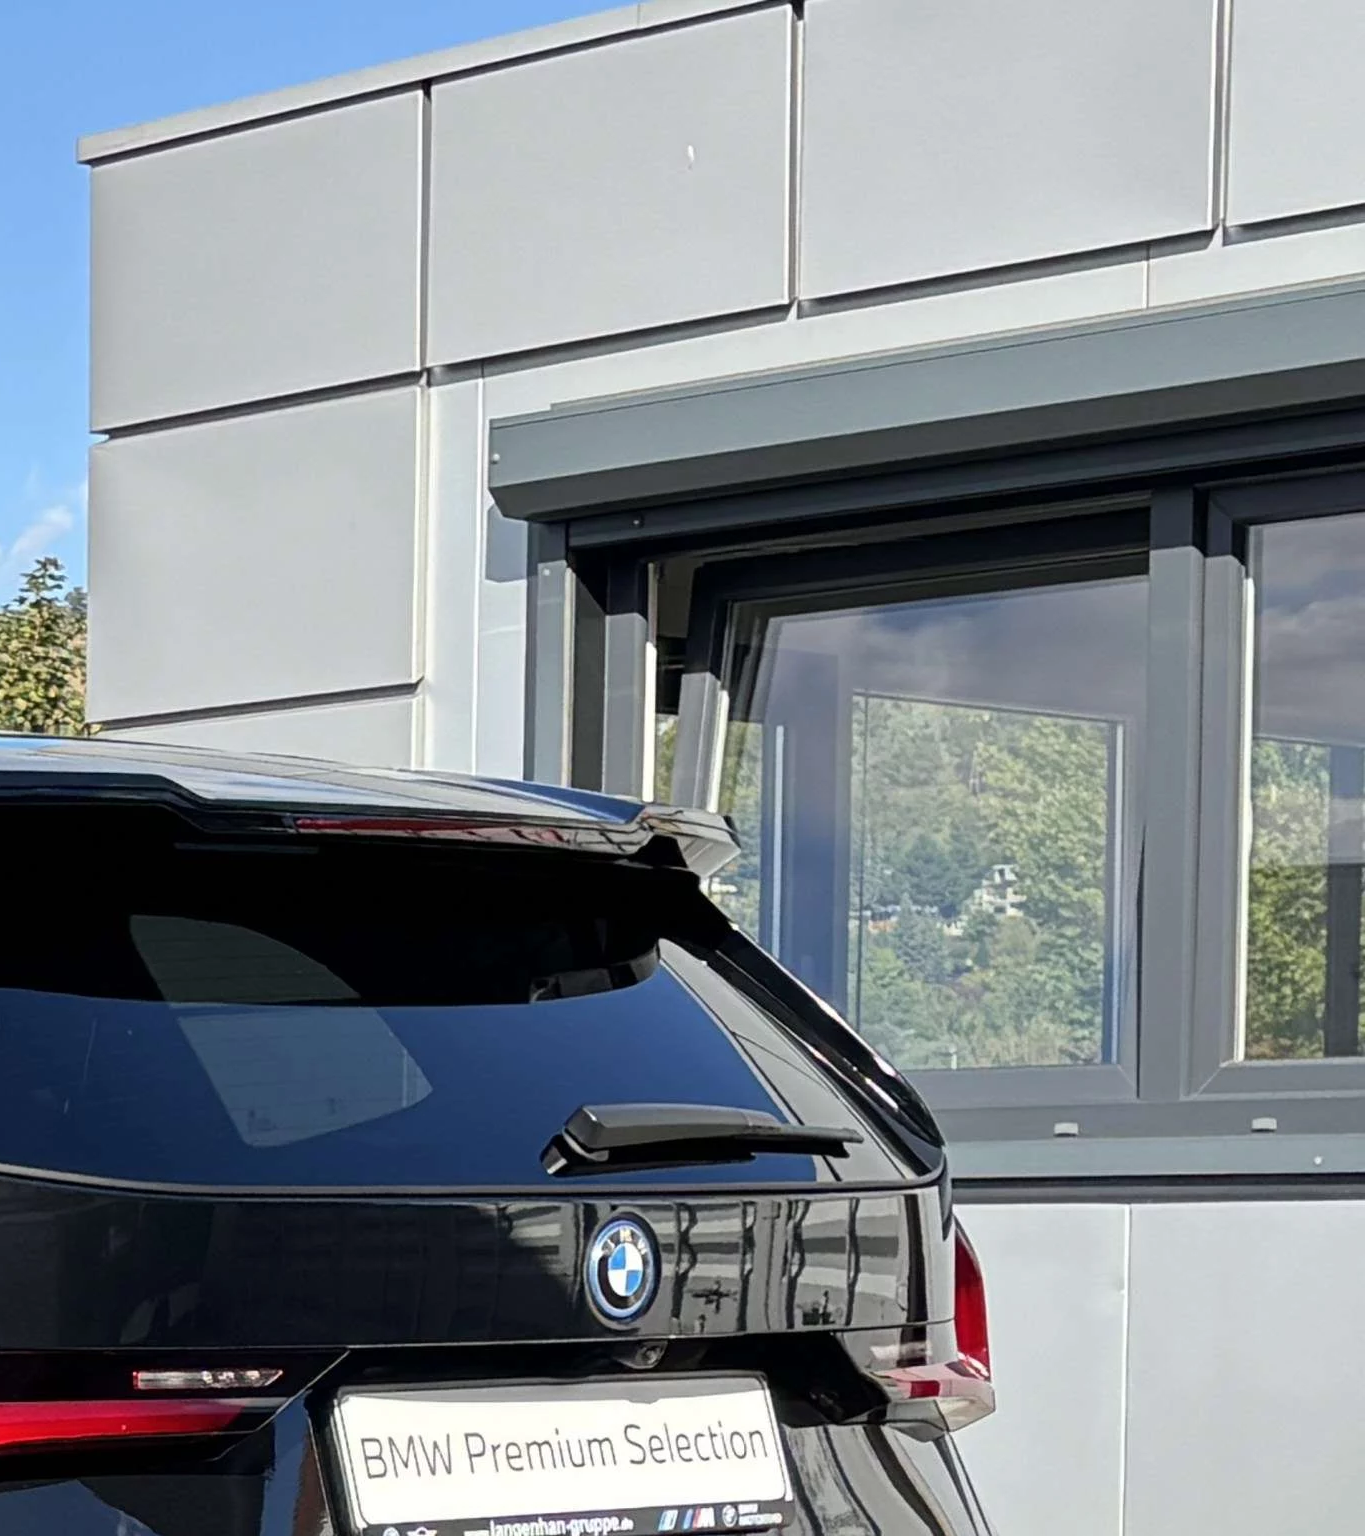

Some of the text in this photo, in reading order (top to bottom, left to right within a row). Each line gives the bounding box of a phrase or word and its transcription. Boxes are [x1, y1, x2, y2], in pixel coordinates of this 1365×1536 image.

[360, 1420, 769, 1481] BMW Premium Selection
